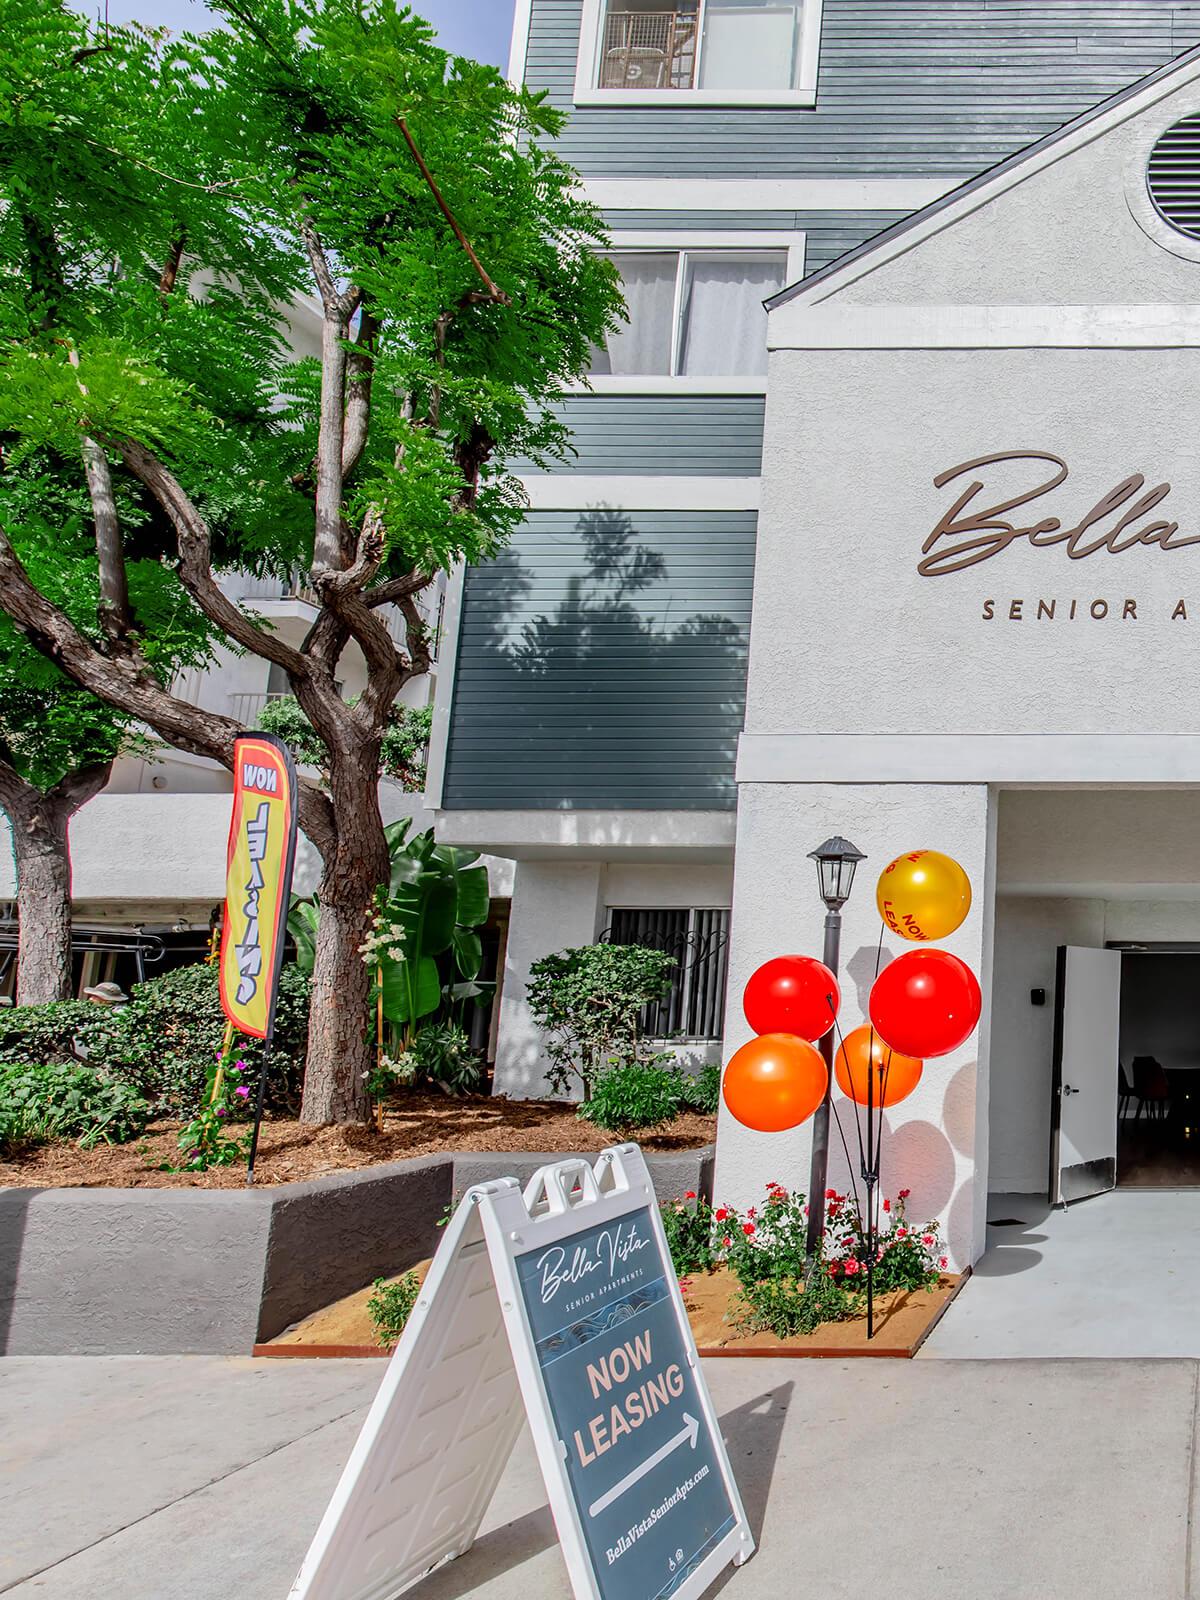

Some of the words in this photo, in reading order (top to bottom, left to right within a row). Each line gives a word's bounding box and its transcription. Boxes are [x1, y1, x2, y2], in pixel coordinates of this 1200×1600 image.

[982, 599, 1139, 620] SENIOR
[536, 1246, 603, 1304] Bella
[596, 1223, 650, 1277] Vista
[564, 1291, 596, 1312] SENIOR
[599, 1268, 644, 1296] APARTMENTS
[586, 1329, 652, 1399] NOW
[573, 1364, 684, 1468] LEASING
[605, 1464, 710, 1566] BellaVistaSeniorApts.com
